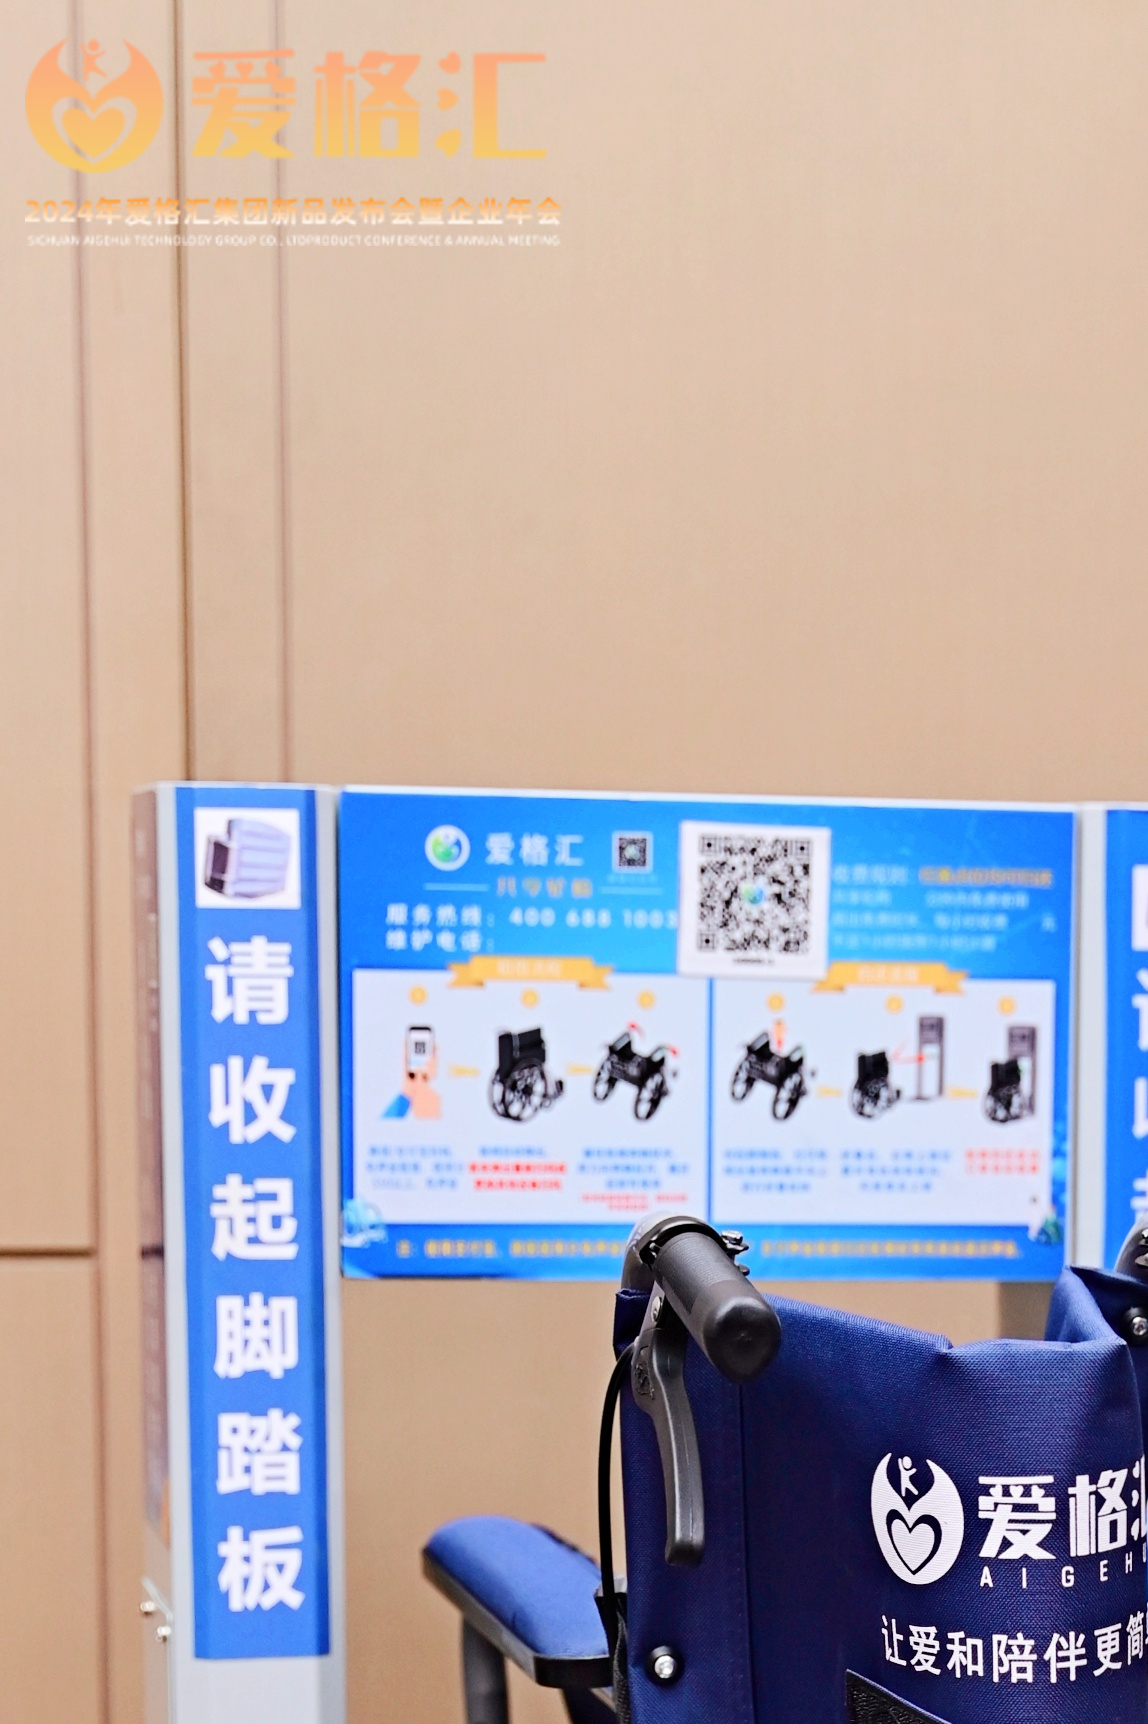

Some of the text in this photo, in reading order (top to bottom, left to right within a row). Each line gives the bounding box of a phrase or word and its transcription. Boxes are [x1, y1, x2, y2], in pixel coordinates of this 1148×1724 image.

[485, 831, 584, 866] 爱格汇
[204, 935, 306, 1613] 请收起脚踏板
